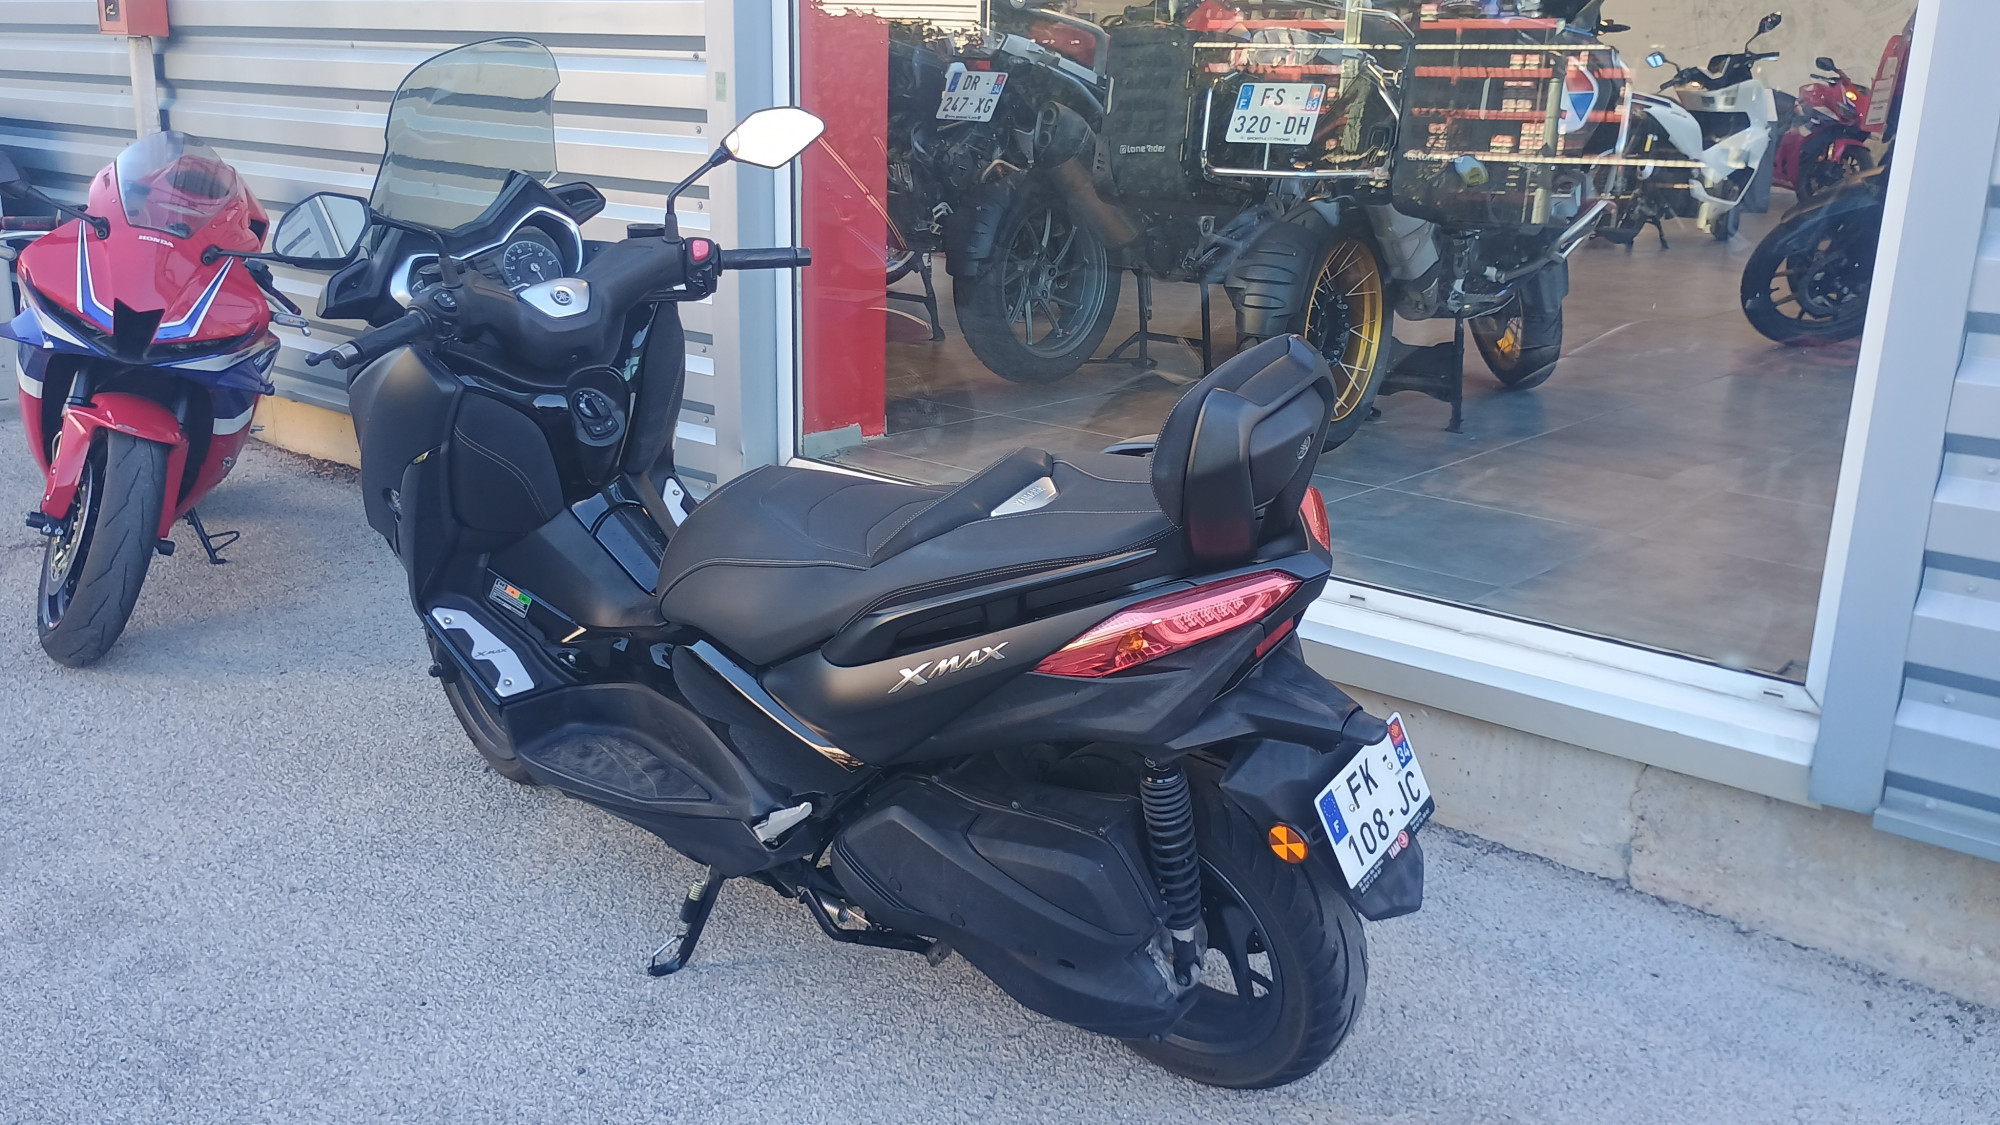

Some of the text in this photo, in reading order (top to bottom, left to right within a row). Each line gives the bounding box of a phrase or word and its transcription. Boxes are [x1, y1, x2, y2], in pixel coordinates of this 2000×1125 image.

[962, 75, 981, 91] DR
[1239, 99, 1247, 109] F
[1260, 88, 1286, 106] FS
[1306, 100, 1317, 110] 83
[138, 234, 174, 248] HONDA
[1396, 746, 1411, 763] 34
[1345, 757, 1379, 810] FK
[1333, 819, 1340, 834] F
